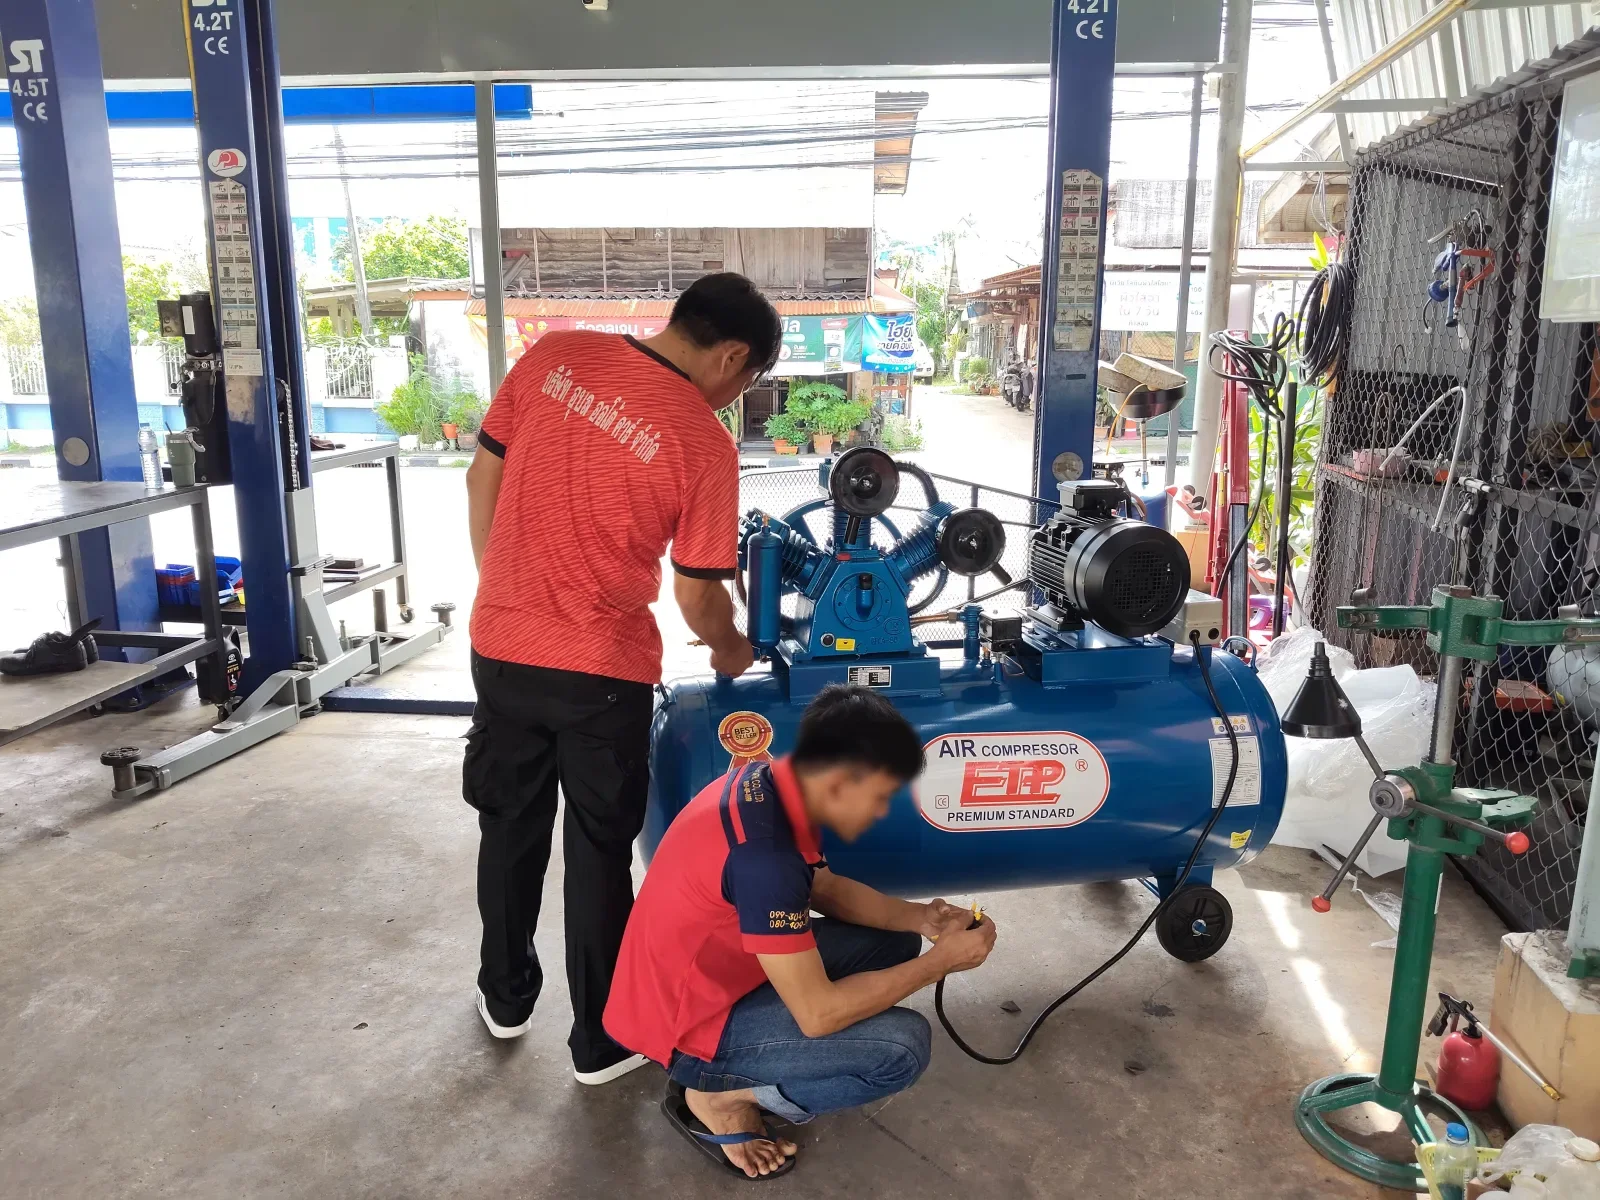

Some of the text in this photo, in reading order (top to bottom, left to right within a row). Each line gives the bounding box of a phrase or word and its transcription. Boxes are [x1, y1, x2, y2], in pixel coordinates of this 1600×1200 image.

[194, 12, 233, 31] 4.2T
[1076, 20, 1104, 39] CE
[204, 36, 229, 55] CE
[9, 39, 44, 73] ST
[12, 78, 48, 97] 4.5T
[23, 102, 48, 121] CE
[734, 726, 756, 736] BEST
[735, 732, 758, 740] SELLER
[939, 739, 1080, 758] AIR COMPRESSOR
[948, 808, 1074, 822] PREMIUM STANDARD
